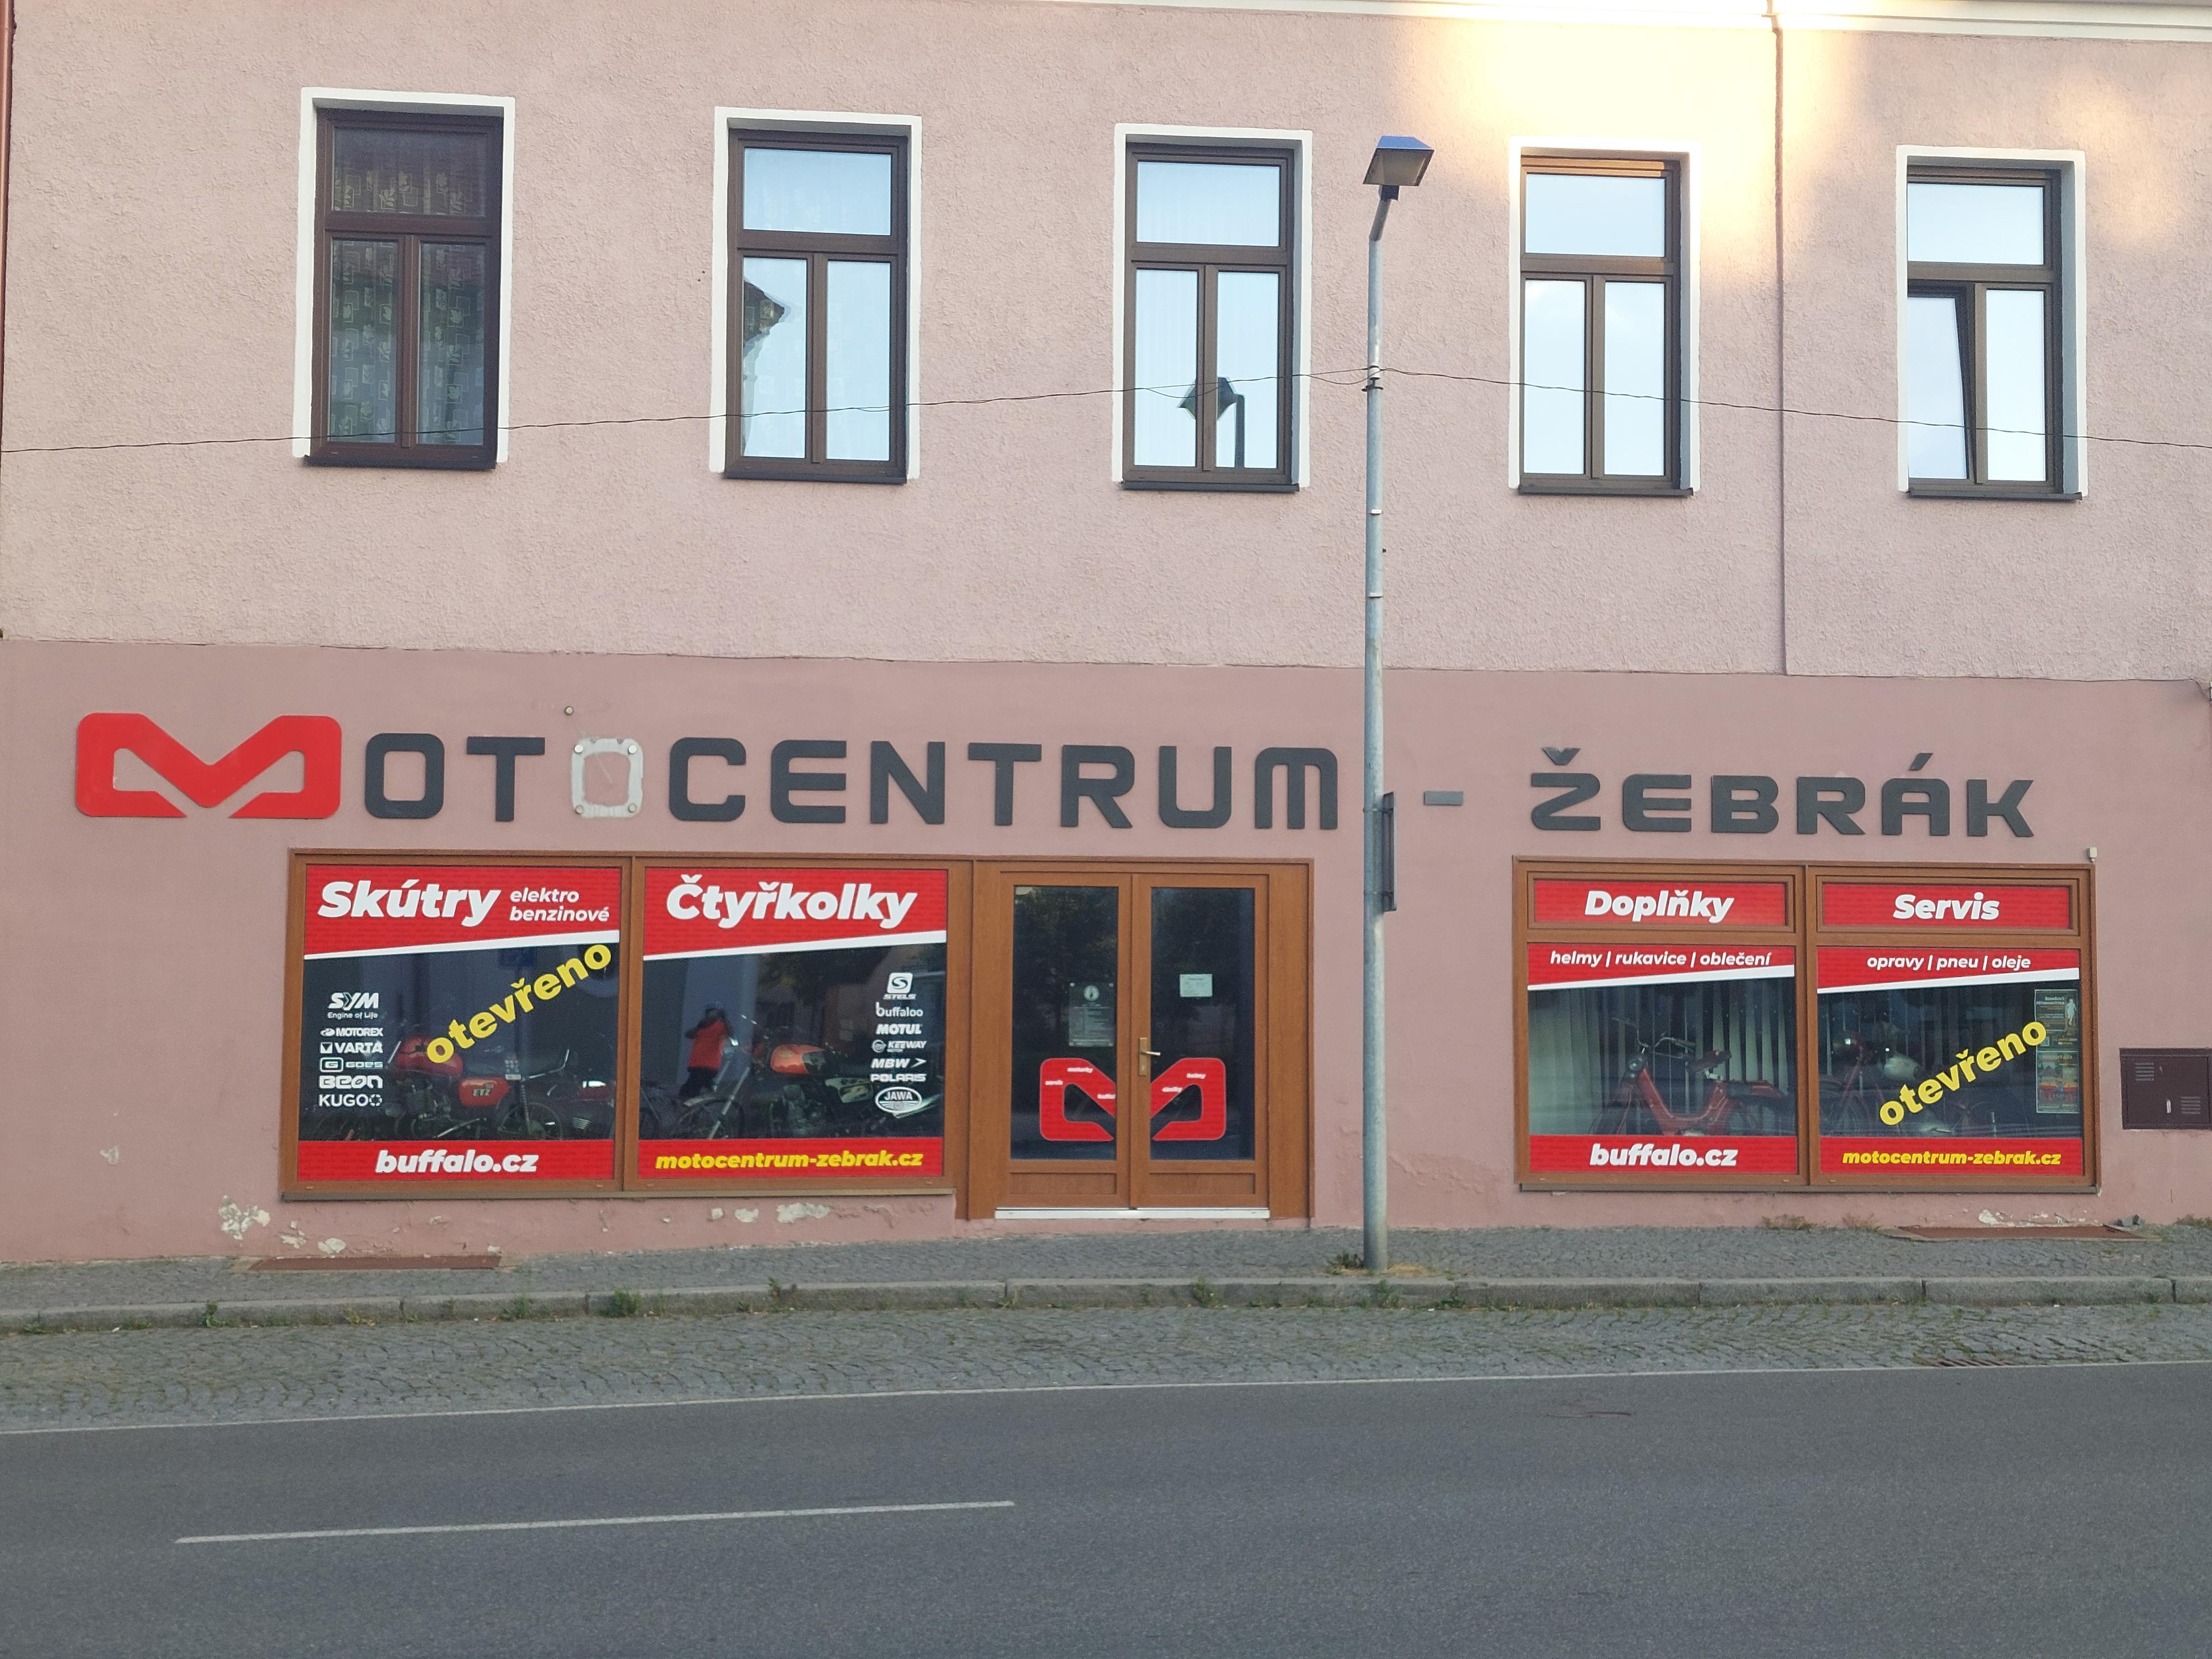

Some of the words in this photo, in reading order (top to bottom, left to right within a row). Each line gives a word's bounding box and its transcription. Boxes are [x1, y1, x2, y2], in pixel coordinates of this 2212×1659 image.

[1530, 747, 2034, 837] ŽEBRÁK
[317, 879, 501, 927] Skútry
[510, 888, 579, 903] elektro
[667, 874, 918, 929] Čtyřkolky
[509, 905, 609, 922] benzinové
[1585, 890, 1734, 923] Doplňky
[1893, 892, 2000, 920] Servis
[1550, 951, 1602, 967] helmy
[1615, 951, 1687, 965] rukavice
[1700, 952, 1772, 966] oblečení
[1867, 957, 1924, 971] opravy
[1937, 958, 1979, 971] pneu
[1992, 956, 2032, 971] oleje
[328, 993, 379, 1011] SYM
[427, 945, 611, 1063] otevřeno
[336, 1027, 384, 1036] MOTOREX
[876, 1024, 922, 1034] MOTUL
[335, 1042, 383, 1053] VARTA
[871, 1058, 910, 1068] MBW
[870, 1073, 927, 1082] POLARIS
[1880, 1021, 2047, 1125] otevřeno
[884, 1091, 912, 1100] JAWA
[375, 1149, 539, 1173] buffalo.cz
[655, 1150, 924, 1169] motocentrum-zebrak.cz
[1589, 1144, 1739, 1167] buffalo.cz
[1842, 1150, 2062, 1165] motocentrum-zebrak.cz
